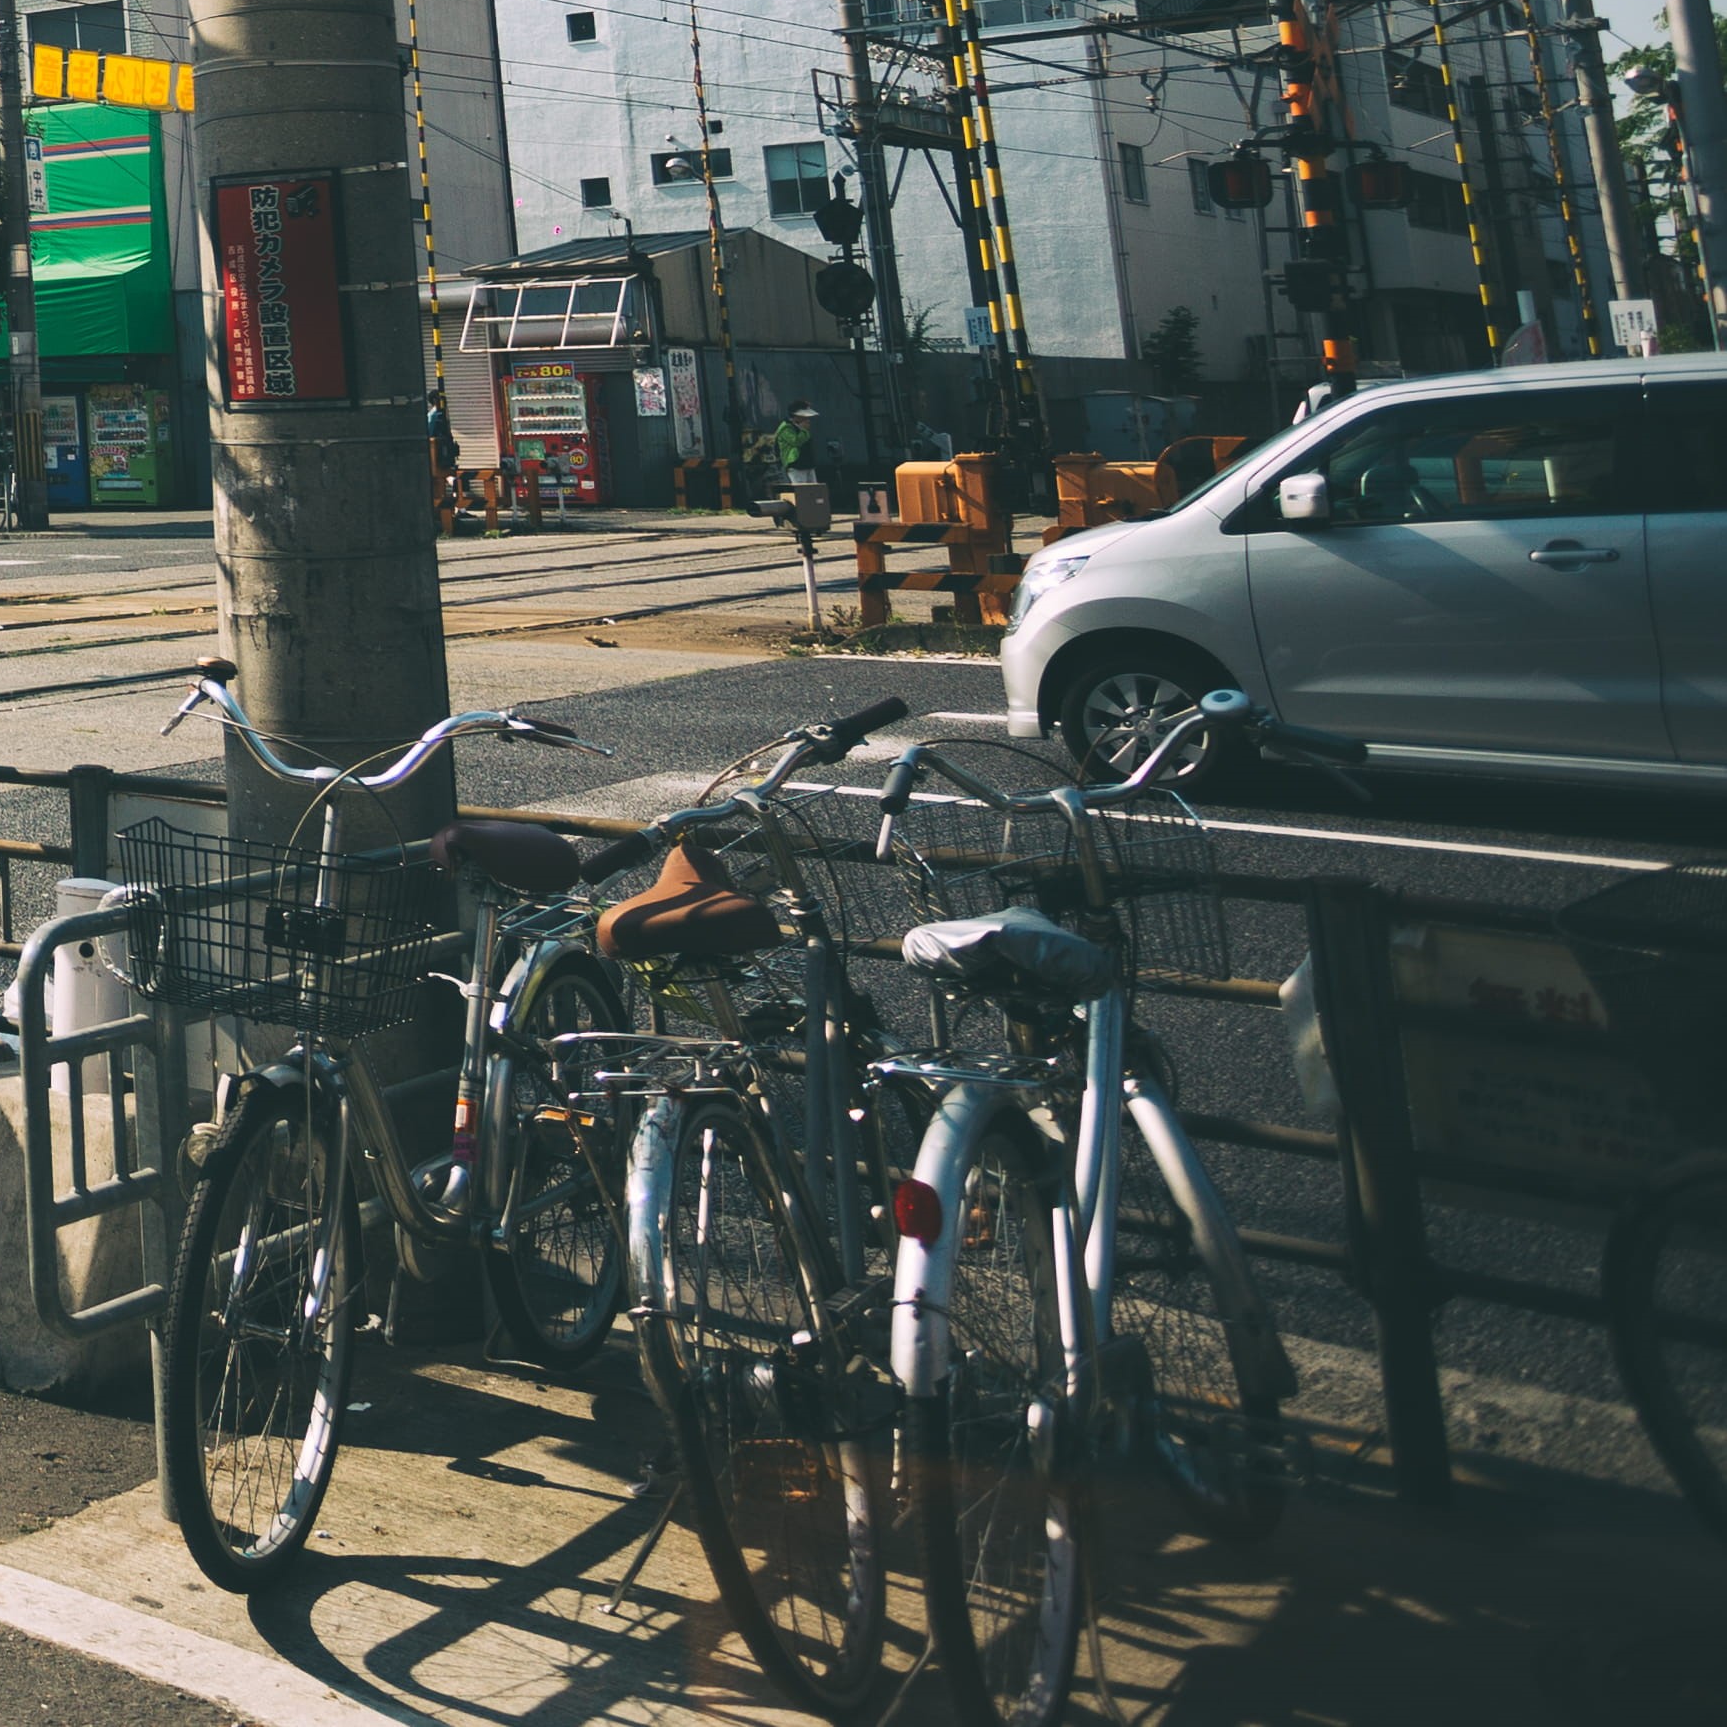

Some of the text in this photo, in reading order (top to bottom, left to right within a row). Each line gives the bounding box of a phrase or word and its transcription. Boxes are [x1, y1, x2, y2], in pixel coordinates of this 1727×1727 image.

[248, 184, 296, 397] 防犯カメラ設置区域
